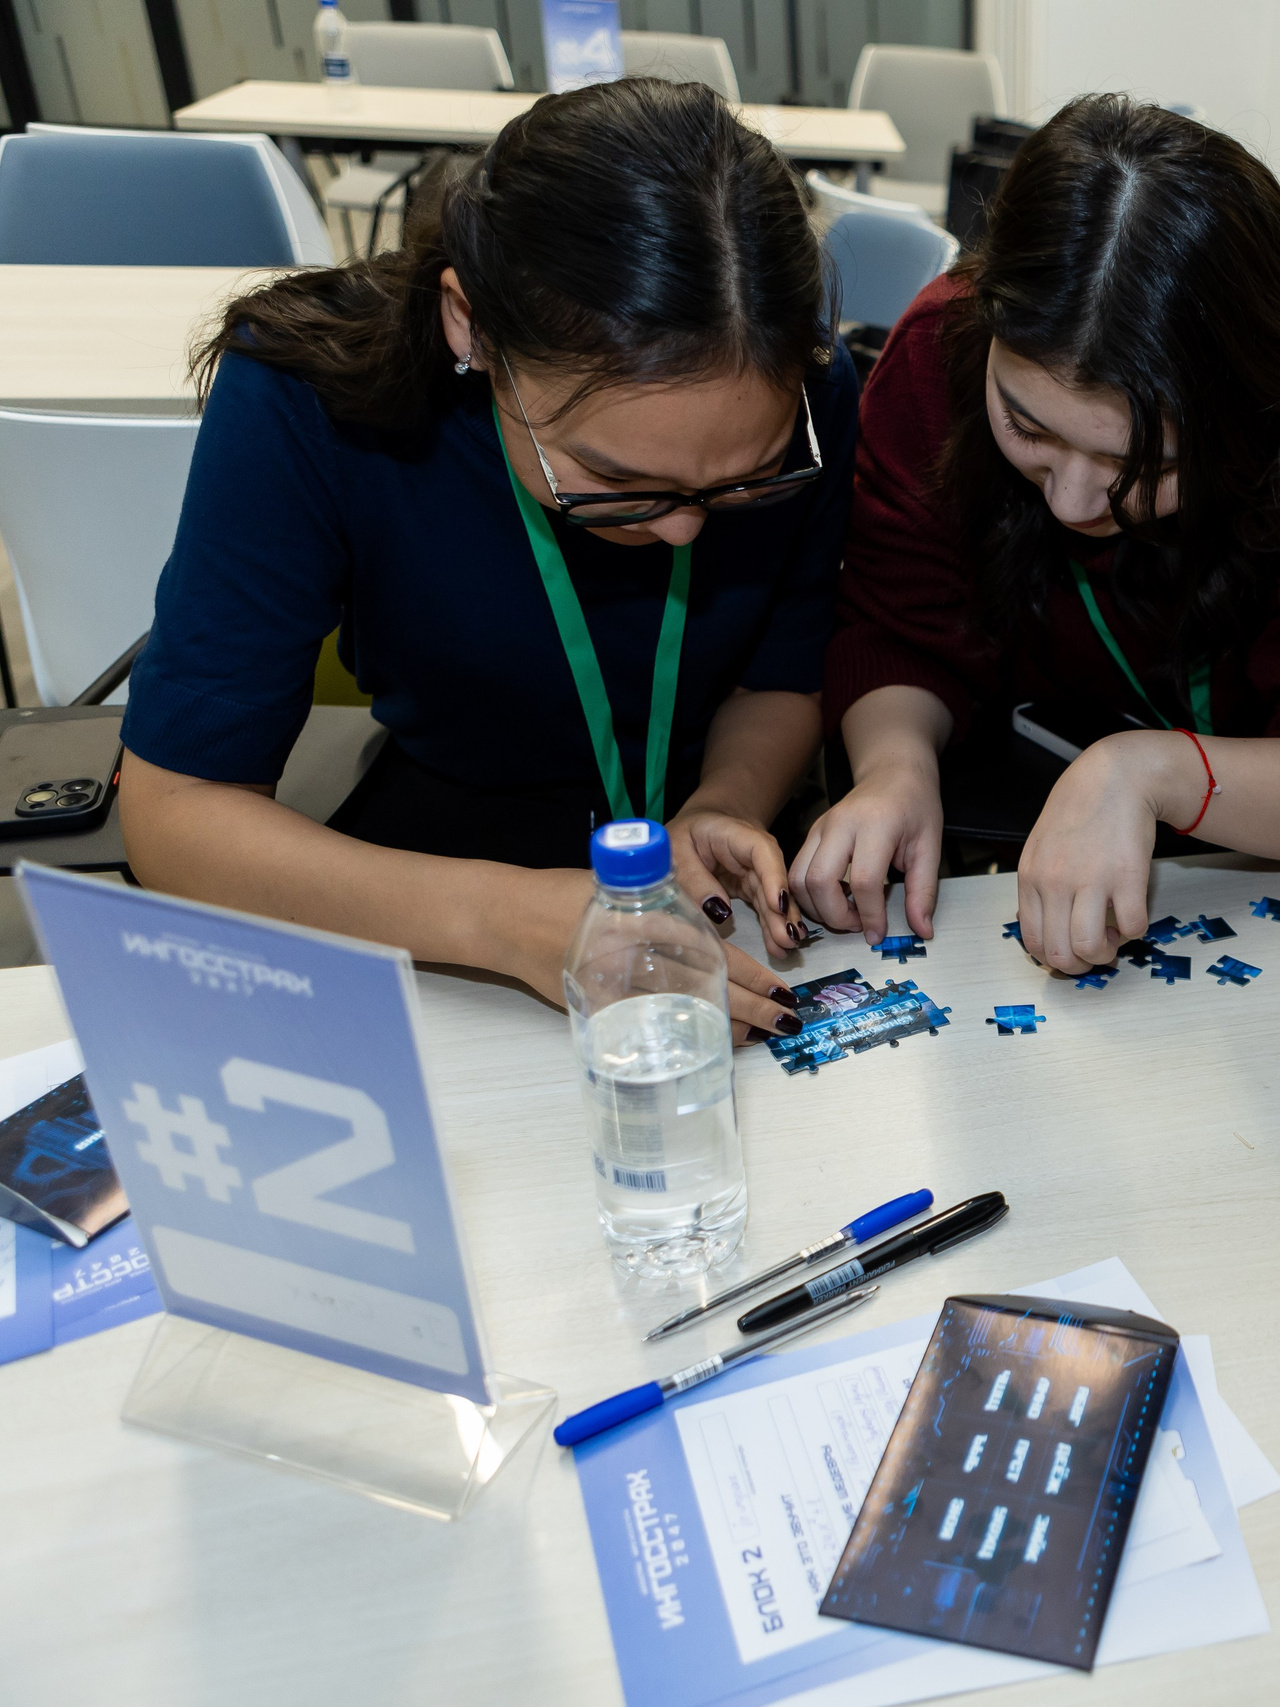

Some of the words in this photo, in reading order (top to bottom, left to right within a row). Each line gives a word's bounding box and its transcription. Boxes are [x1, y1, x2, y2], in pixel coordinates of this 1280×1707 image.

[121, 931, 313, 999] ИНГОССТРАХ
[122, 1057, 416, 1254] #2
[812, 1283, 847, 1305] MARKER
[847, 1259, 896, 1288] PERMANENT
[820, 1443, 849, 1499] ШЕДЕВРЫ
[780, 1492, 804, 1538] ЗВУЧИТ
[624, 1467, 686, 1630] ИНГОССТРАХ
[741, 1545, 763, 1563] 2
[796, 1540, 812, 1565] ЭТО
[748, 1567, 784, 1634] БЛОК
